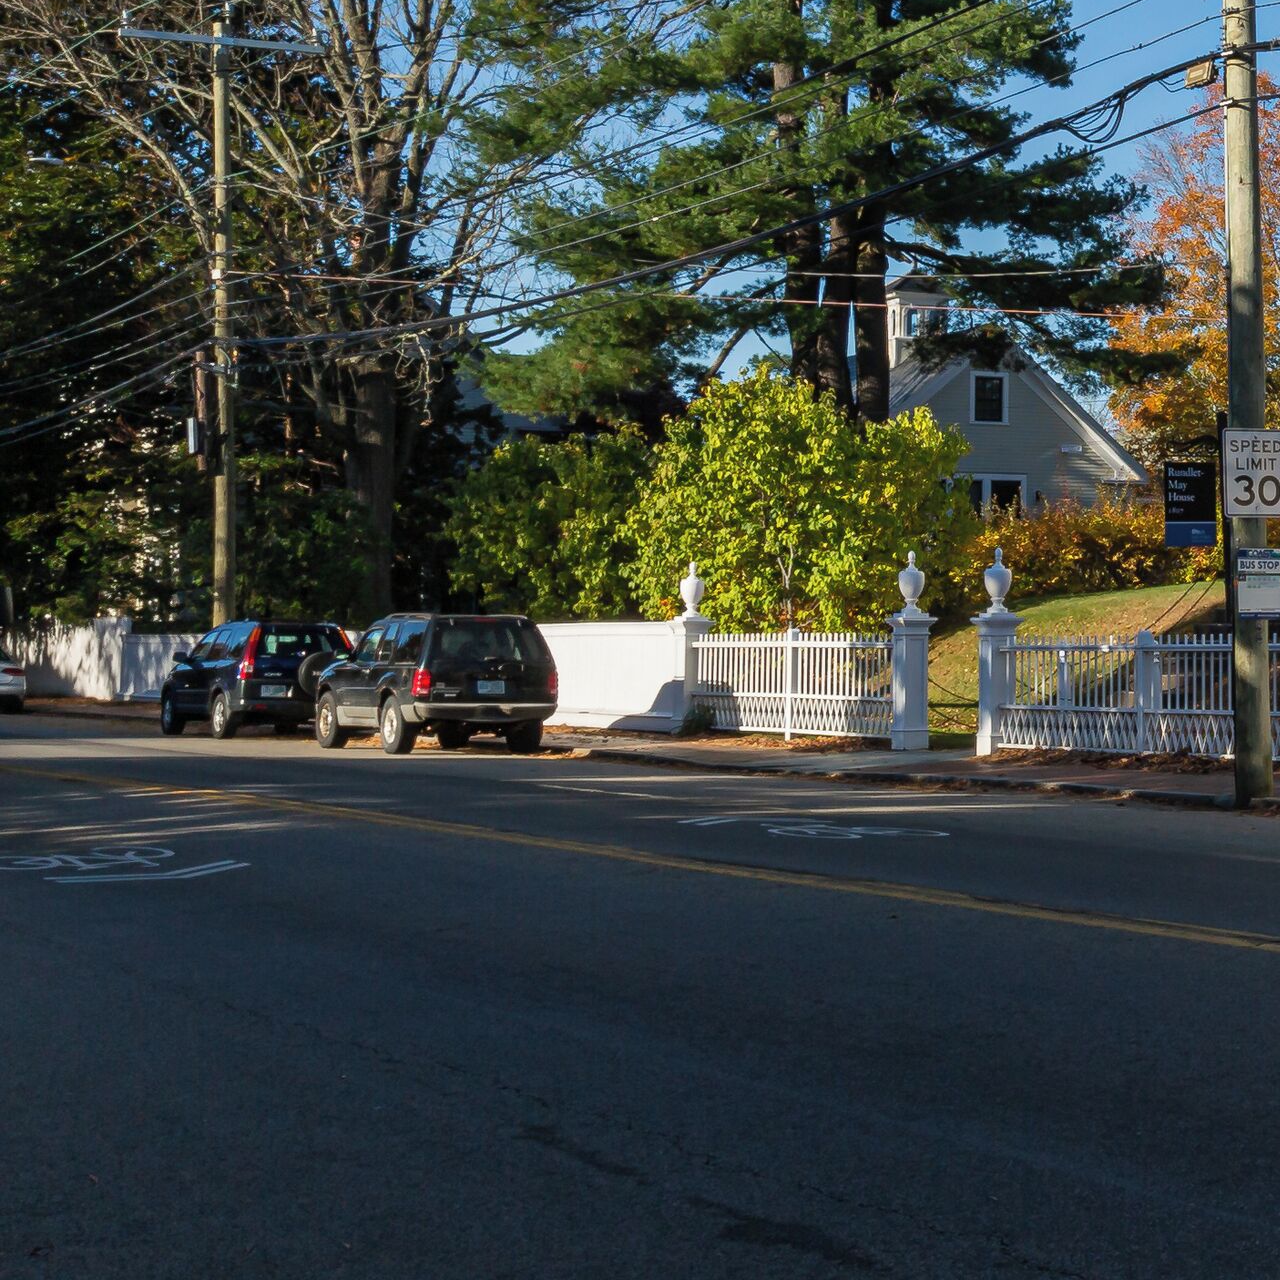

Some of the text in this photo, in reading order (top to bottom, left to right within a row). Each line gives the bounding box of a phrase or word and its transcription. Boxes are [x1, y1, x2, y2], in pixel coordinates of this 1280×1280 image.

[1236, 458, 1277, 470] LIMIT
[1168, 480, 1188, 491] May
[1233, 475, 1280, 506] 30
[1168, 492, 1195, 501] House
[1240, 561, 1280, 570] BUS STOP
